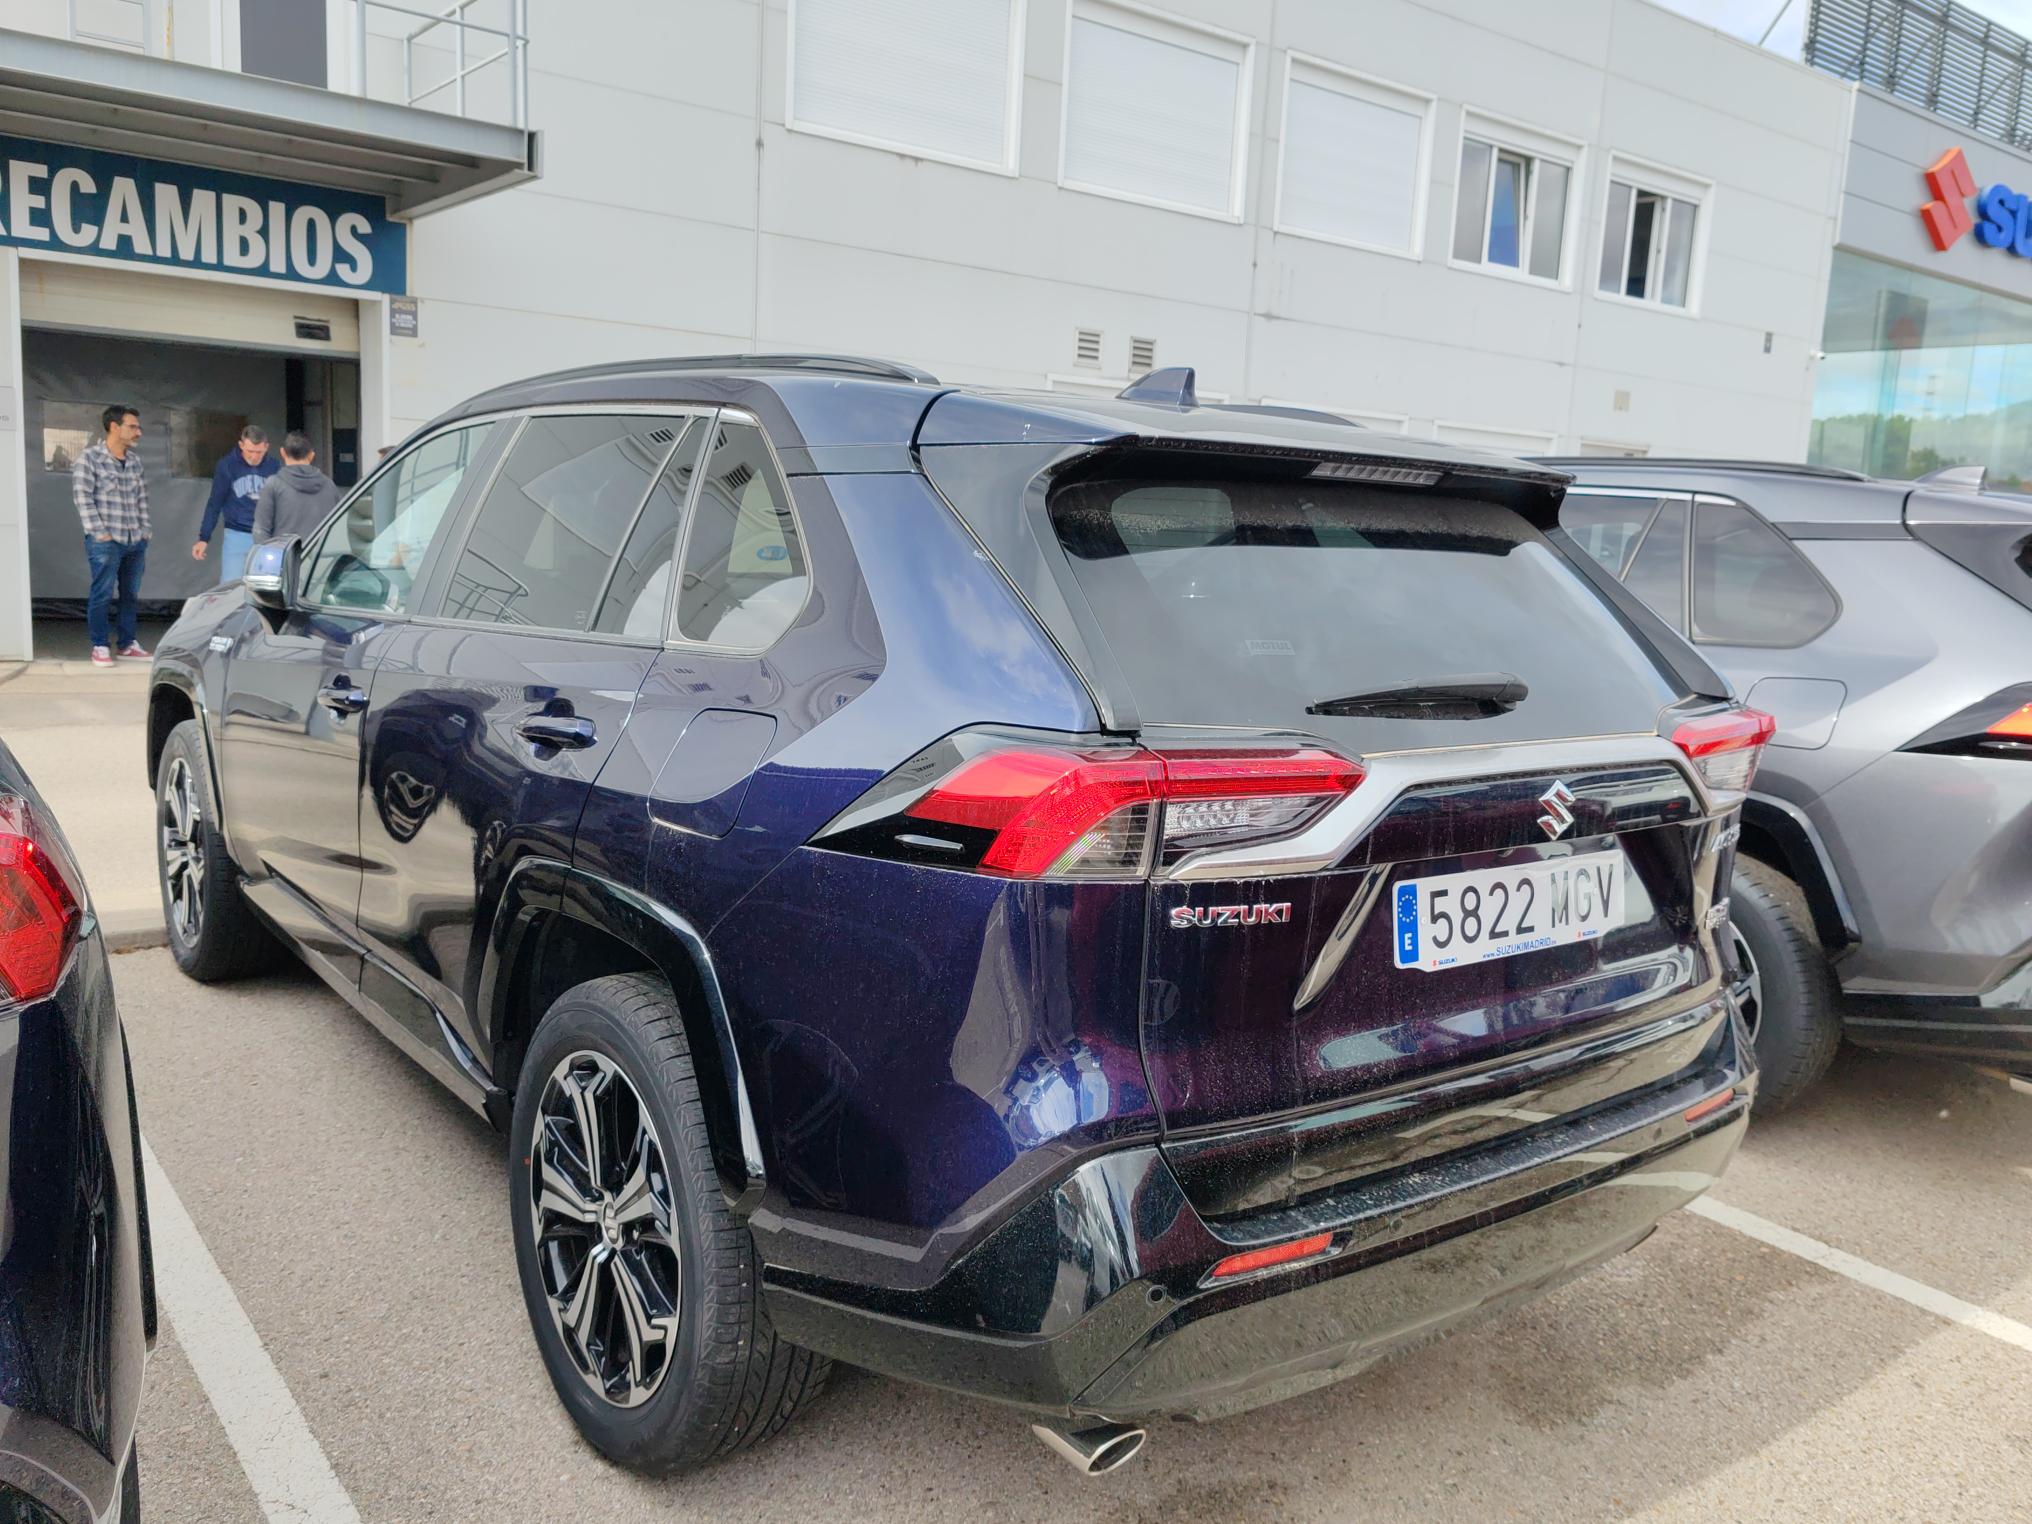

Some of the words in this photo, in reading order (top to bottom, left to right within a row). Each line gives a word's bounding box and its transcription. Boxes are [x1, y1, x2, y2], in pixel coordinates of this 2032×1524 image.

[0, 160, 373, 285] ECAMBIOS
[1170, 902, 1291, 928] SUZUKI
[1429, 877, 1535, 949] 5822
[1551, 863, 1613, 929] MGV
[1403, 932, 1413, 950] E
